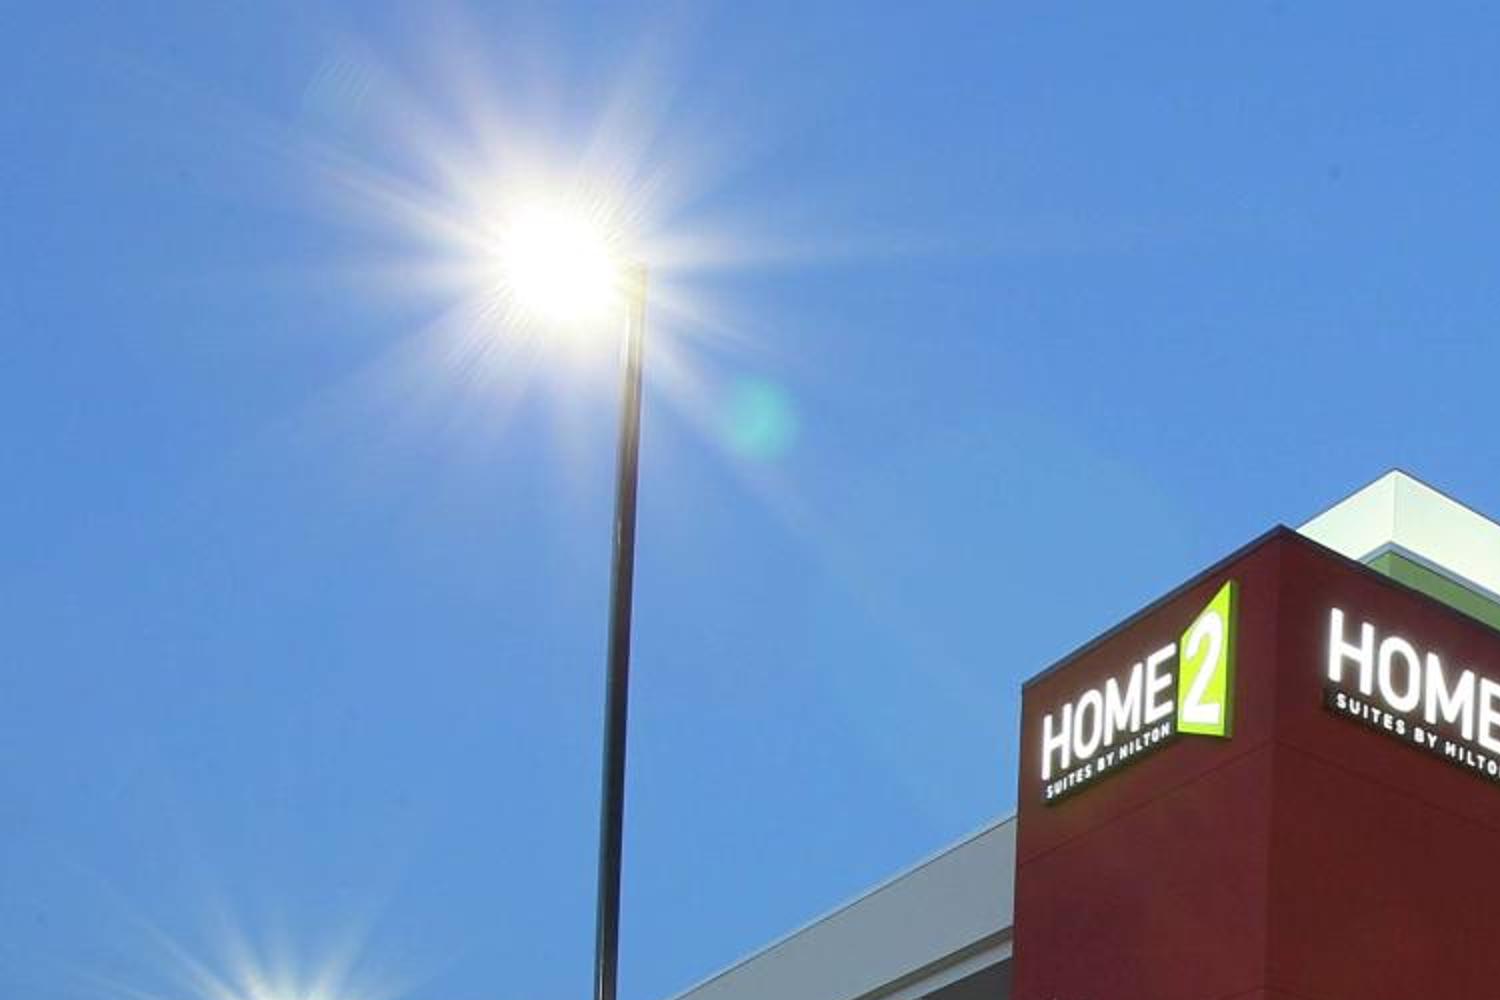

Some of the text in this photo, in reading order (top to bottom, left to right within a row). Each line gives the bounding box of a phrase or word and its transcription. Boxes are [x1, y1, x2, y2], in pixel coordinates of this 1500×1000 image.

[1337, 693, 1406, 736] SUITES
[1413, 726, 1438, 749] BY
[1046, 721, 1172, 799] SUITES BY HILTON
